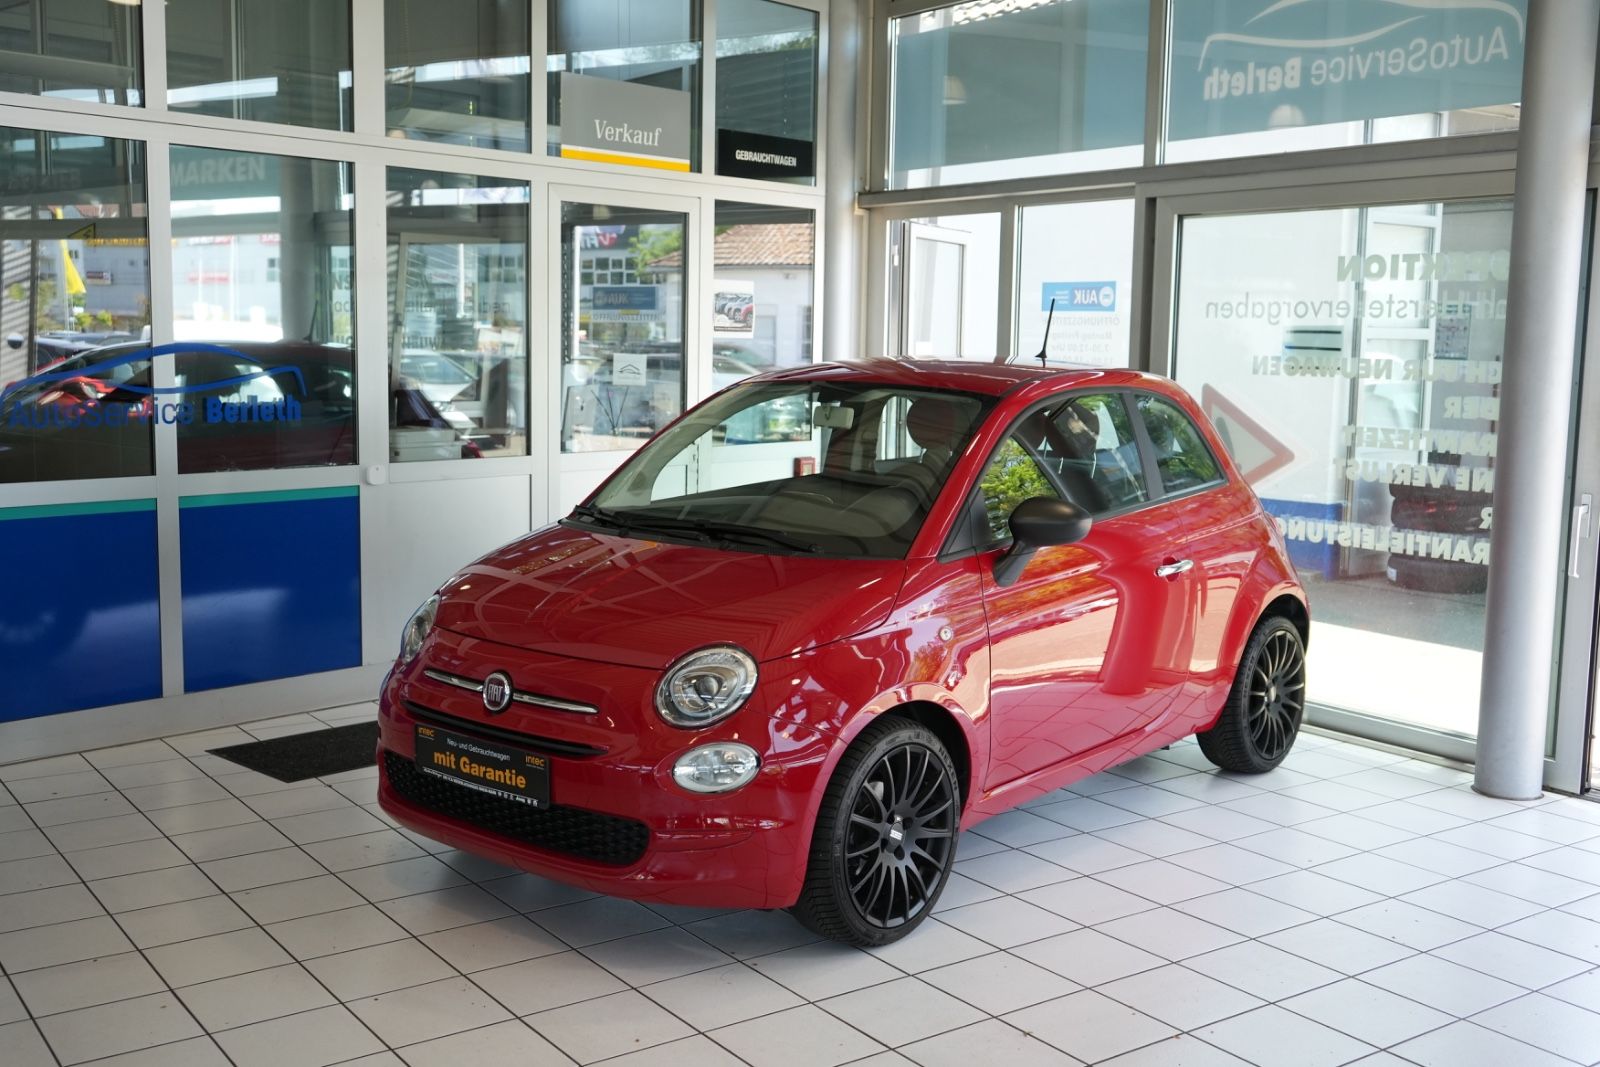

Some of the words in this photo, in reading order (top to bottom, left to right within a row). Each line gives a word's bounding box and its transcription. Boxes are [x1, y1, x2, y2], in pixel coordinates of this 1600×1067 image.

[594, 119, 662, 147] Verkauf
[735, 149, 797, 167] GEBRAUCHTWAGEN
[8, 397, 194, 429] AutoService
[203, 394, 303, 424] Berleth
[488, 684, 503, 702] FIAT
[468, 744, 511, 761] Gebrauchtwagen
[525, 755, 545, 767] intec
[434, 751, 456, 769] mit
[460, 756, 527, 788] Garantie
